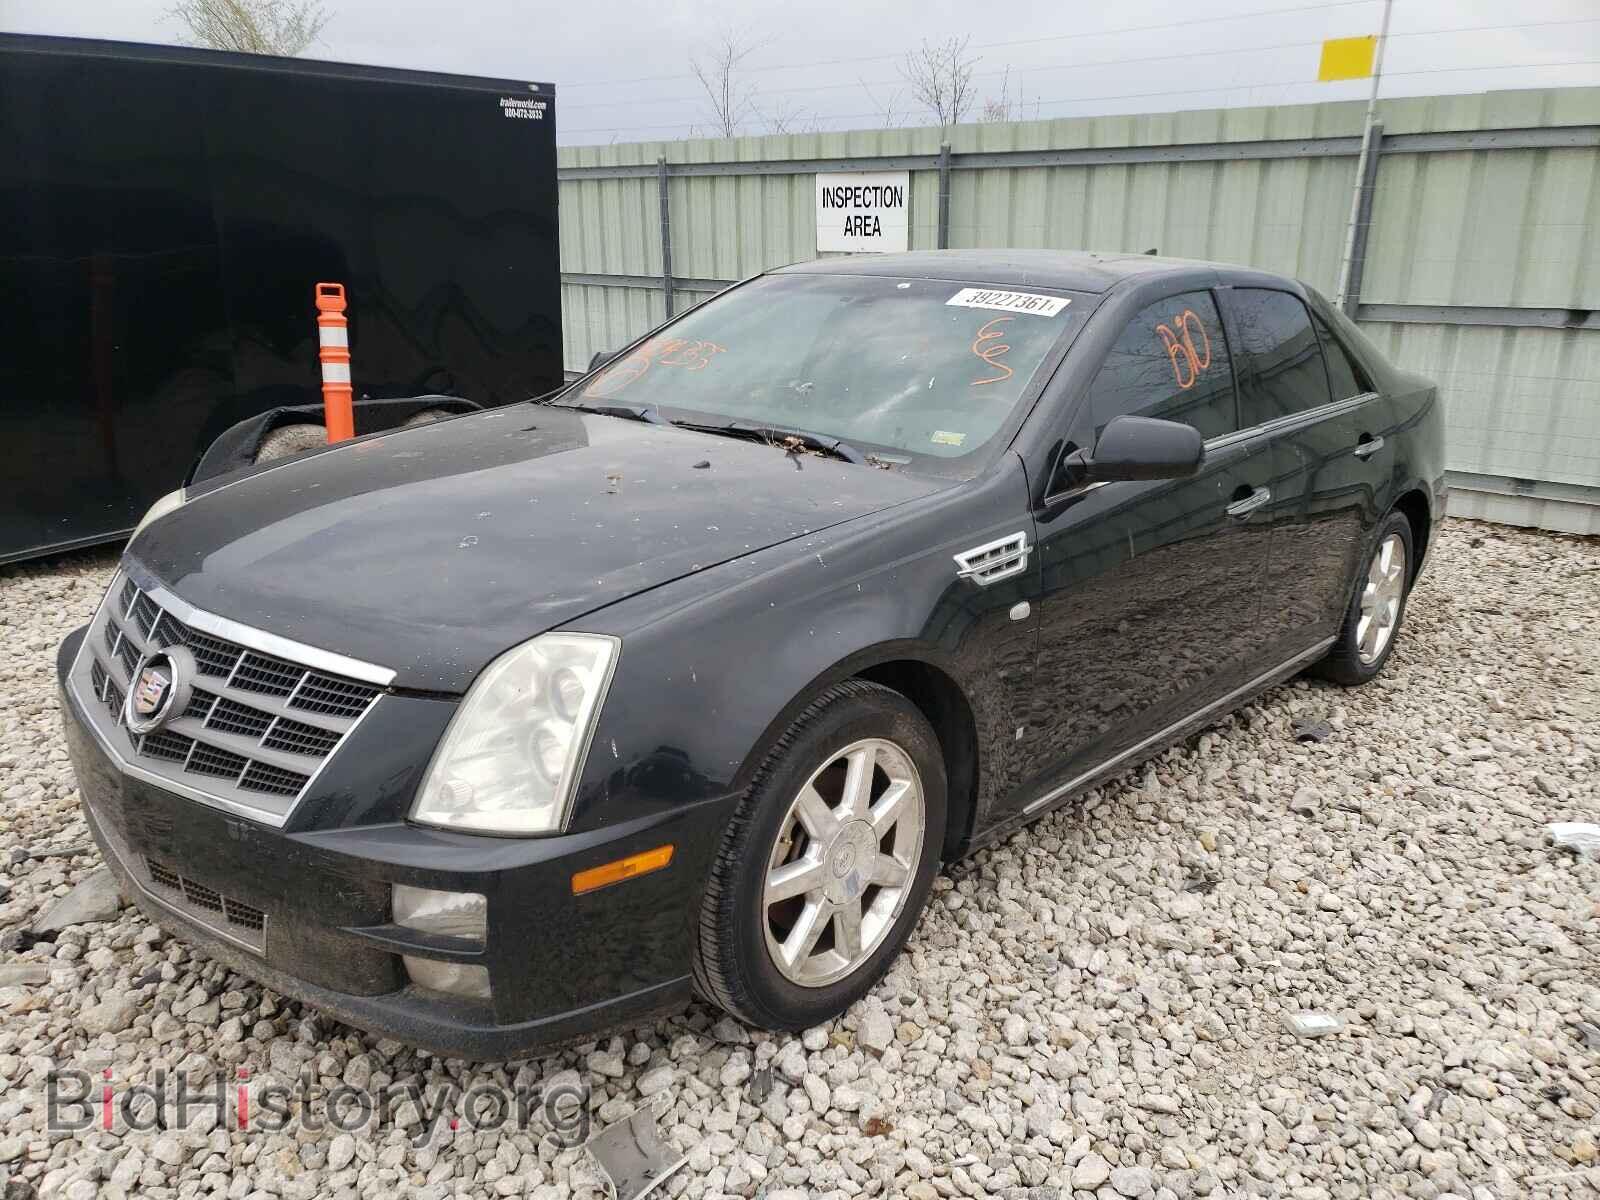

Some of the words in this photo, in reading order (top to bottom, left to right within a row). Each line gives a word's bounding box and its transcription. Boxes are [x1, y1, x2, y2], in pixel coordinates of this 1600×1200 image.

[822, 186, 903, 208] INSPECTION
[844, 215, 882, 237] AREA
[965, 291, 1050, 311] 39227361
